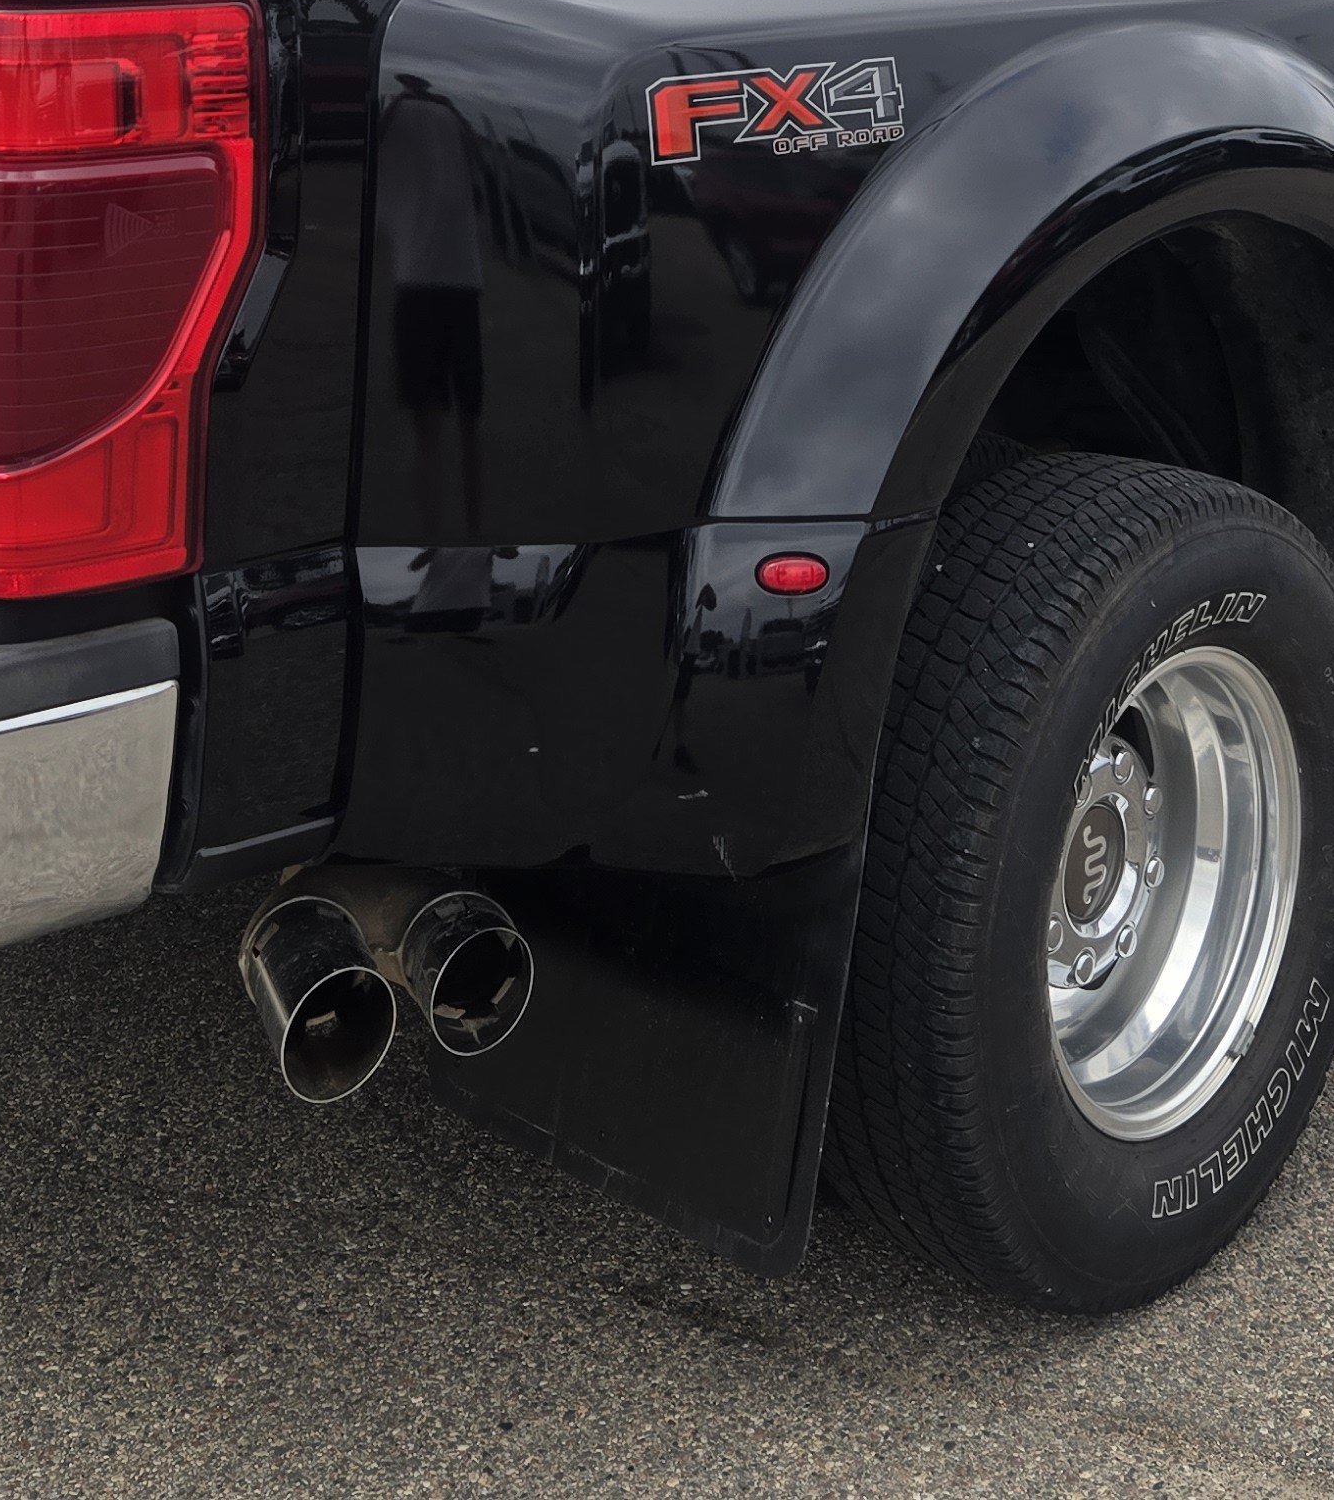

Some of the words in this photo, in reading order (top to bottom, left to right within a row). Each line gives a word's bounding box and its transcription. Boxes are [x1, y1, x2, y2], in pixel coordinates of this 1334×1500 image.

[645, 56, 905, 166] FX4
[772, 134, 828, 156] OFF
[836, 124, 905, 149] ROAD
[1151, 977, 1330, 1219] MICHELIN
